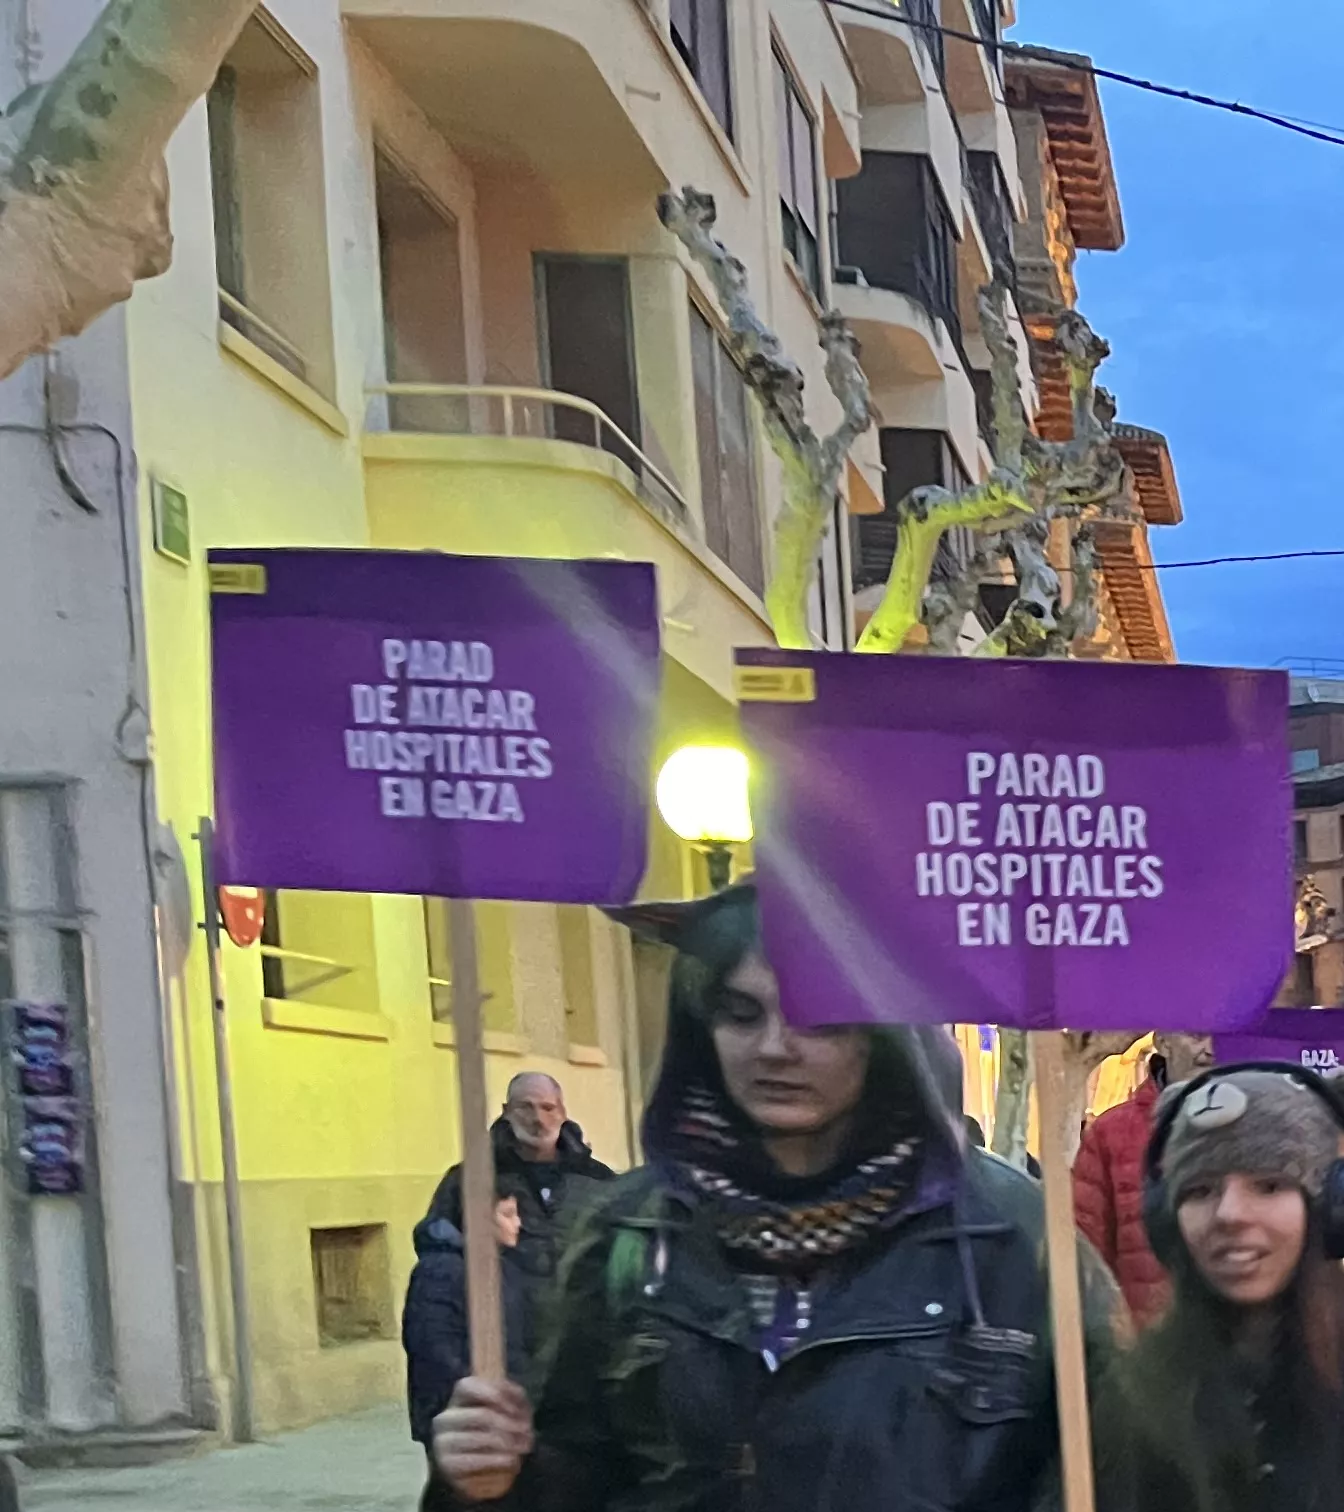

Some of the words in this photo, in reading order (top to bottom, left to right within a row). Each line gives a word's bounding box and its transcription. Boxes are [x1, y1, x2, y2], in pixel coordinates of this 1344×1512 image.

[382, 638, 494, 682] PARAD
[350, 683, 399, 725] DE
[405, 686, 537, 729] ATACAR
[345, 729, 553, 777] HOSPITALES
[967, 752, 1104, 798] PARAD
[379, 777, 426, 818] EN
[431, 780, 525, 822] GAZA
[926, 801, 982, 847] DE
[996, 803, 1147, 848] ATACAR
[916, 852, 1163, 898] HOSPITALES
[957, 902, 1009, 947] EN
[1025, 903, 1130, 947] GAZA
